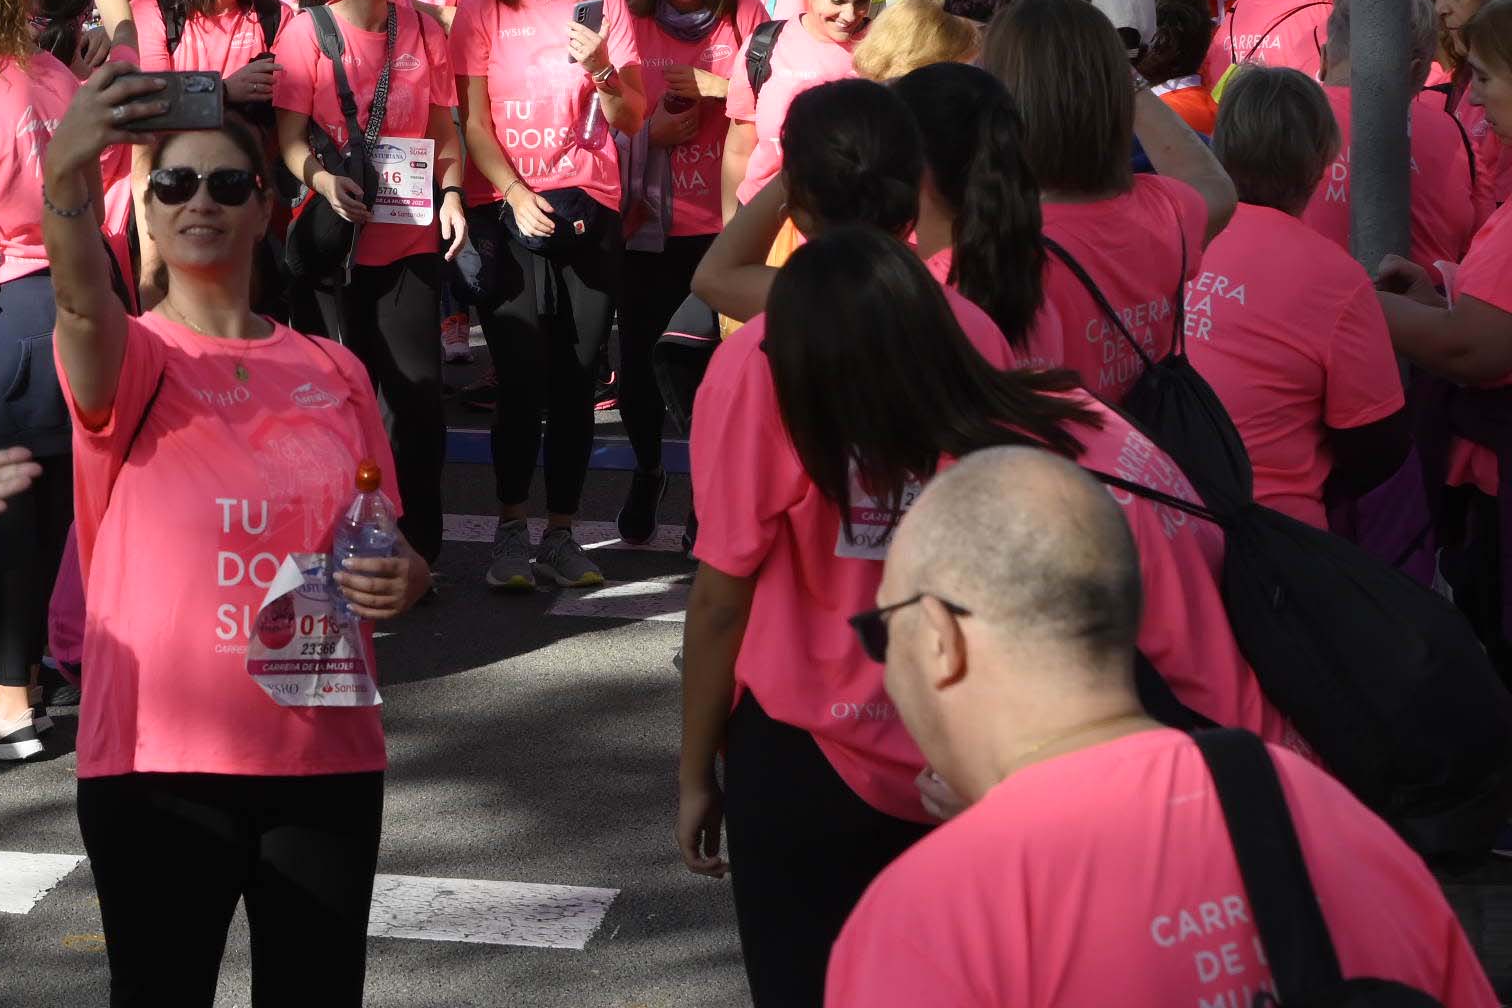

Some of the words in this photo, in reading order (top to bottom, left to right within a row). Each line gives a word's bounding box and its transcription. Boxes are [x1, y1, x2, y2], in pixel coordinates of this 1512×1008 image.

[1224, 35, 1281, 52] CARRERA
[503, 100, 532, 120] TU
[215, 497, 268, 535] TU
[1195, 942, 1246, 985] DE
